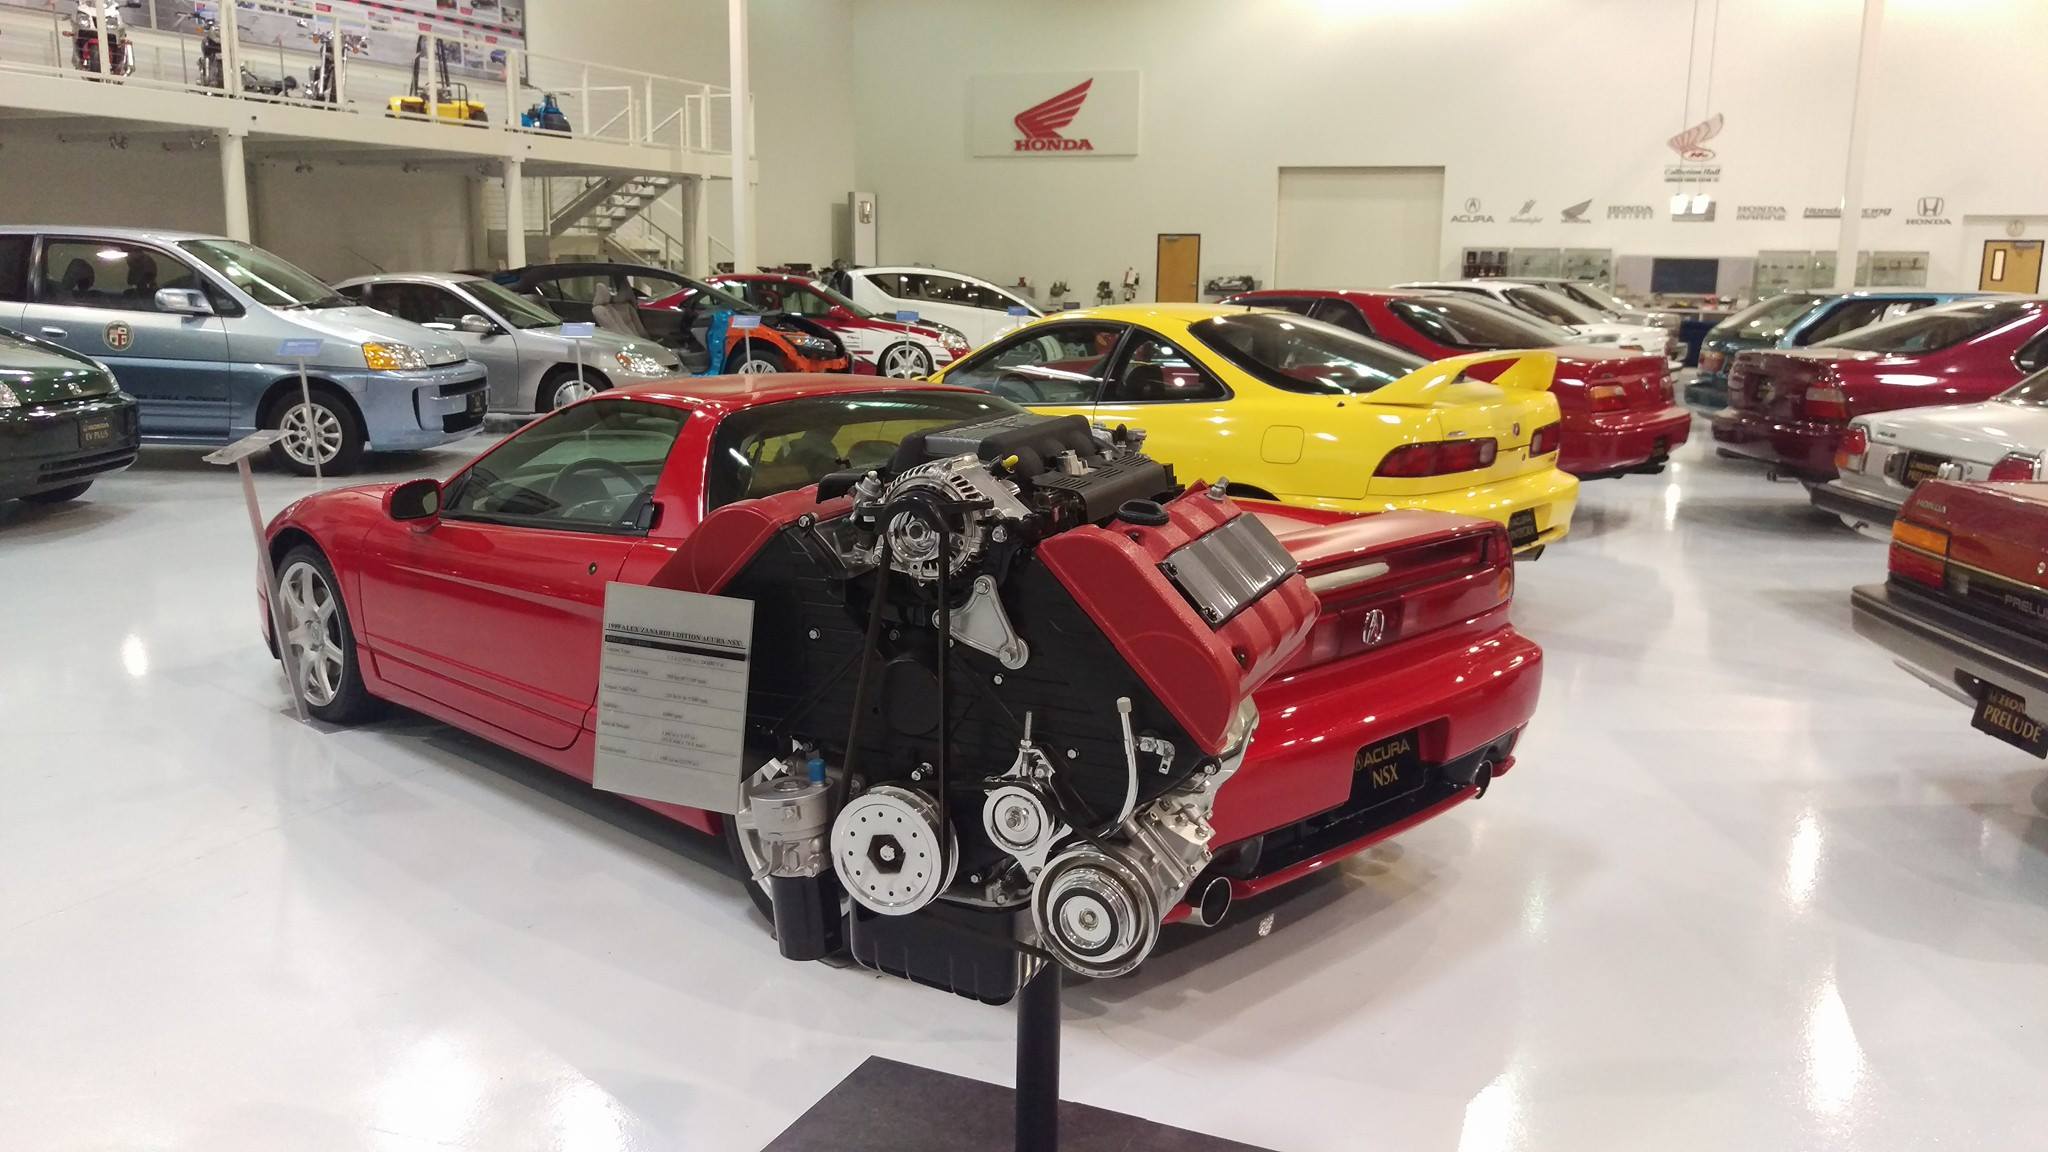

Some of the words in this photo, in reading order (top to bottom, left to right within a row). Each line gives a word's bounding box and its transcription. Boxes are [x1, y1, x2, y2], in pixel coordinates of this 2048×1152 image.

[1014, 138, 1094, 151] HONDA
[1450, 214, 1495, 223] ACURA
[1905, 217, 1952, 226] HONDA
[2003, 593, 2048, 620] PRELU
[1983, 703, 2042, 744] PRELUDE
[1364, 738, 1410, 767] ACURA
[1372, 763, 1399, 789] NSX
